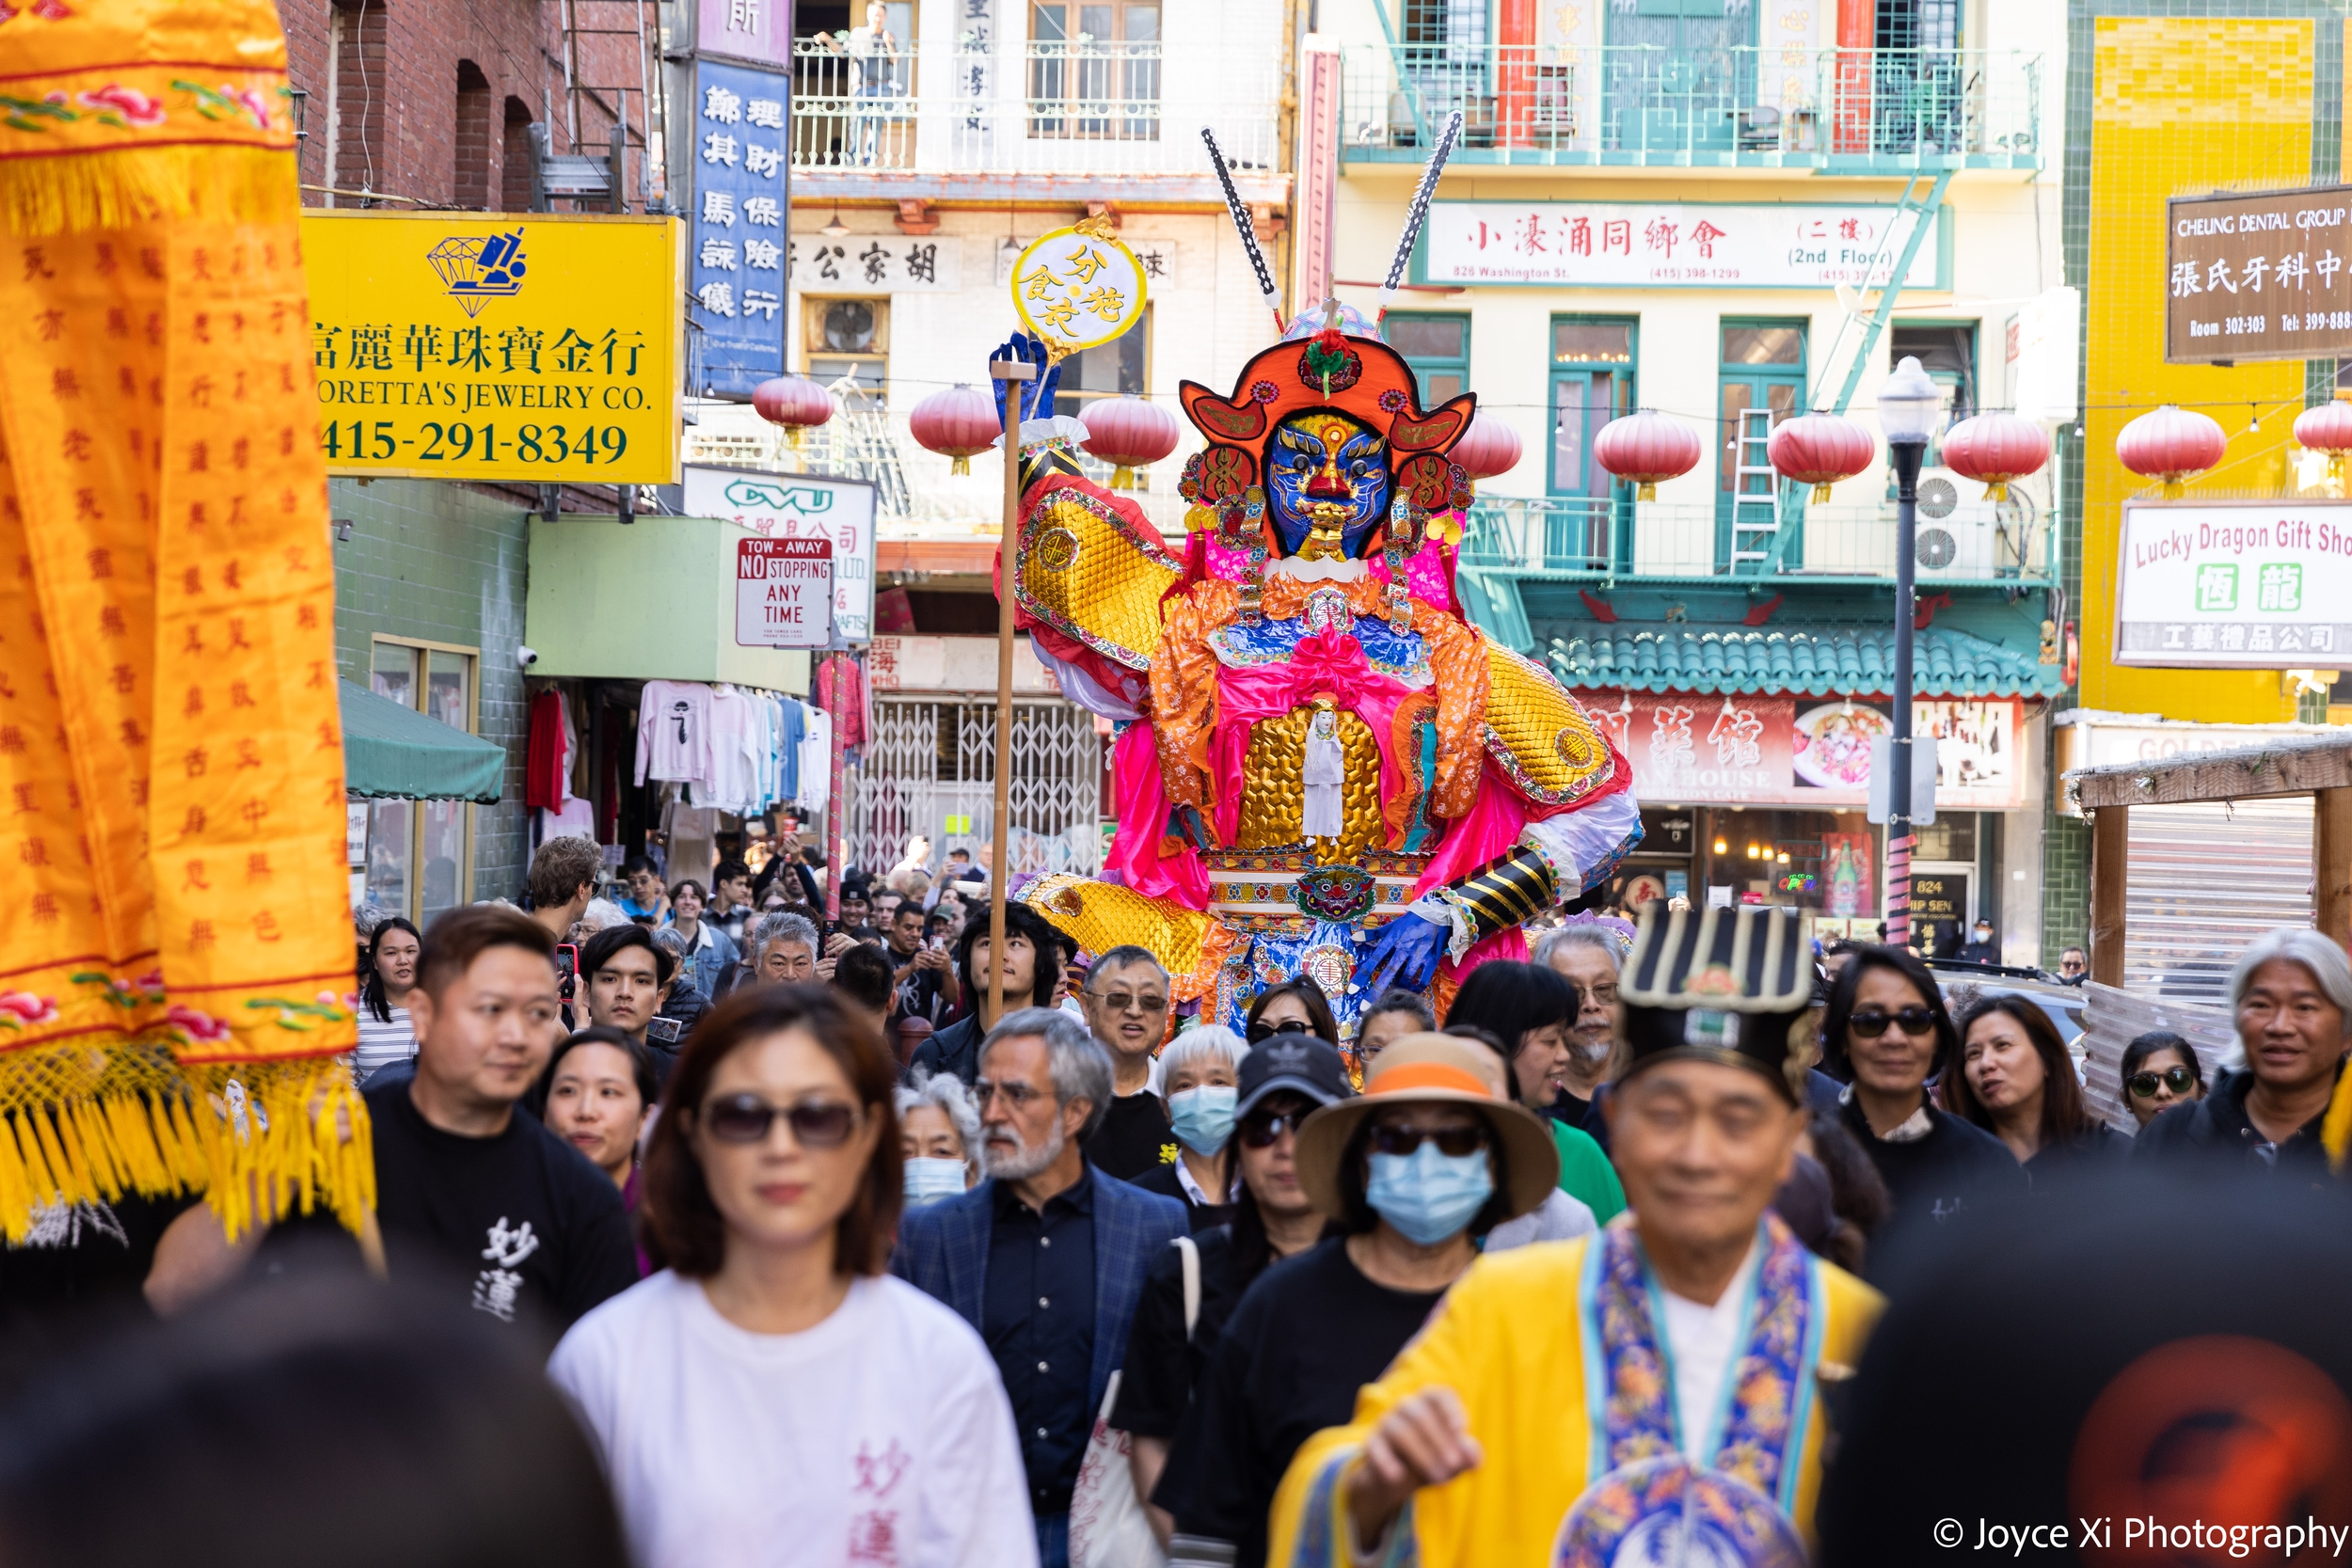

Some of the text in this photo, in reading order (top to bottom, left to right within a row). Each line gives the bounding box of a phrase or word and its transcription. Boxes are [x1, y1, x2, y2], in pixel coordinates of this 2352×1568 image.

[742, 99, 785, 321] 理財保險行
[2177, 208, 2346, 237] CHEUNG DENTAL GROUP
[1063, 244, 1108, 284] 分
[1788, 248, 1826, 267] (2nd
[1017, 264, 1065, 301] 食
[1454, 266, 1570, 279] 826 Washington St.
[1650, 267, 1681, 279] (415)
[1819, 269, 1850, 281] (415)
[2170, 249, 2352, 298] 張氏牙科中
[2190, 319, 2219, 337] Room
[2282, 313, 2300, 331] Tel:
[311, 323, 646, 376] 富麗華珠寶金行
[461, 382, 595, 414] JEWELRY
[603, 387, 652, 411] CO.
[321, 420, 628, 465] 415-291-8349
[2136, 530, 2193, 569] Lucky
[2200, 523, 2268, 555] Dragon
[2277, 520, 2312, 549] Gift
[740, 554, 827, 578] NO STOPPING
[767, 584, 801, 601] ANY
[764, 606, 803, 623] TIME
[2162, 625, 2334, 652] 工藝禮品公司
[1679, 768, 1772, 787] HOUSE
[1778, 877, 1817, 892] OPEN
[1916, 880, 1944, 895] 824
[1928, 899, 1953, 912] SEN
